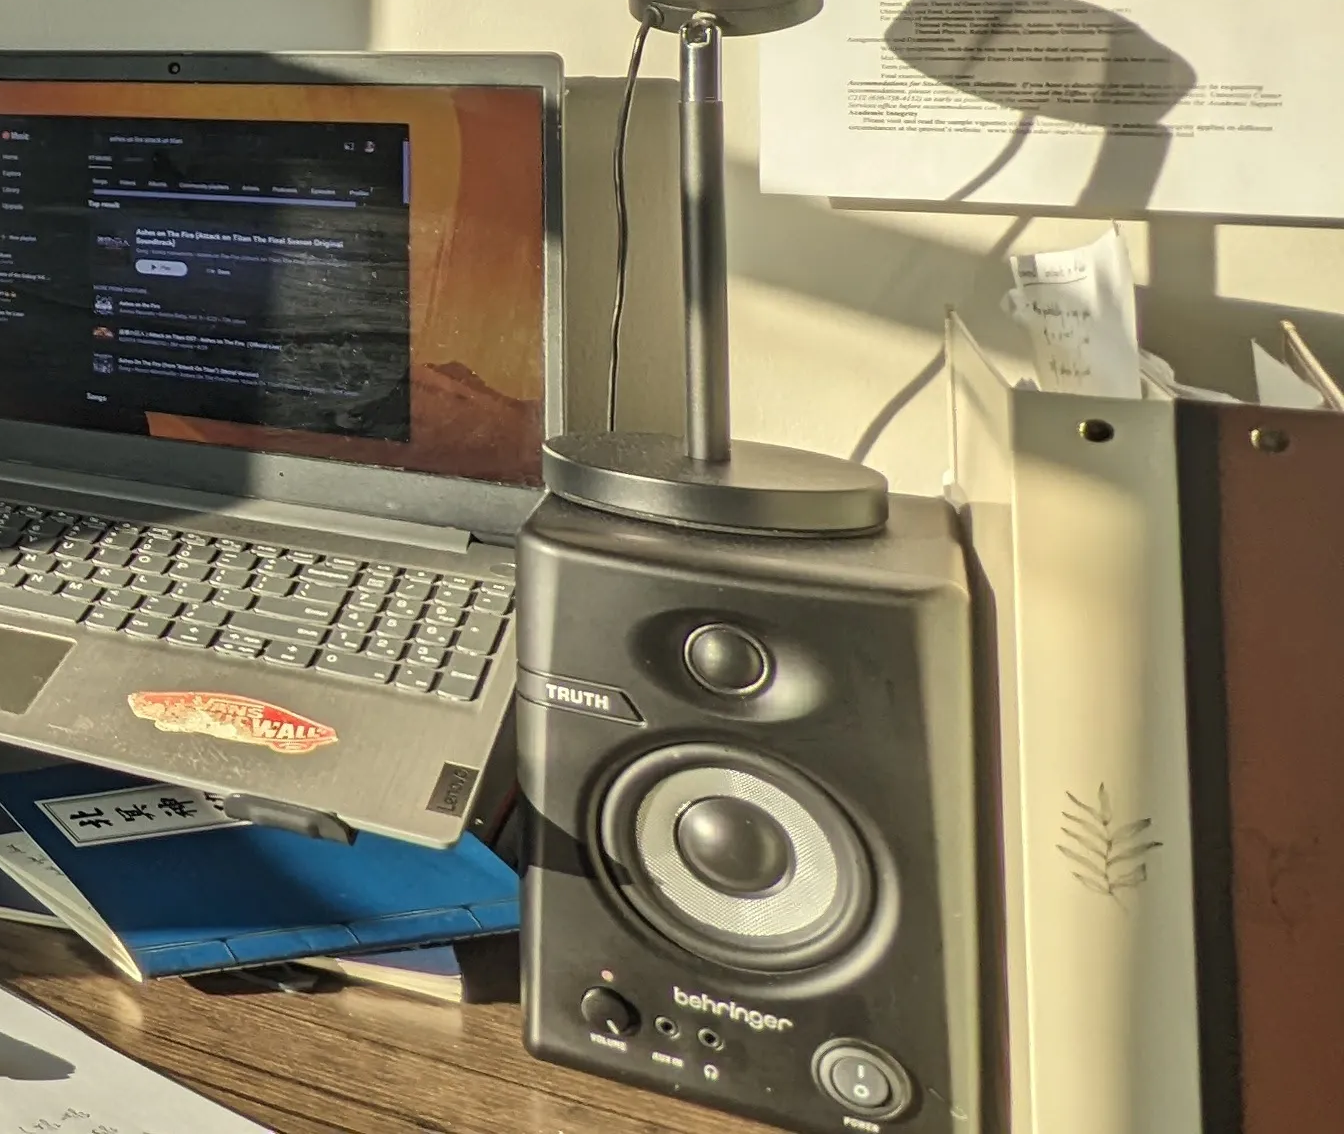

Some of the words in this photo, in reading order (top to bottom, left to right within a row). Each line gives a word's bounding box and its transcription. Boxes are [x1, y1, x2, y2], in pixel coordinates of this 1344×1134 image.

[167, 230, 179, 238] The
[203, 698, 264, 719] VANS
[545, 683, 611, 712] TRUTH
[672, 986, 794, 1033] behringer
